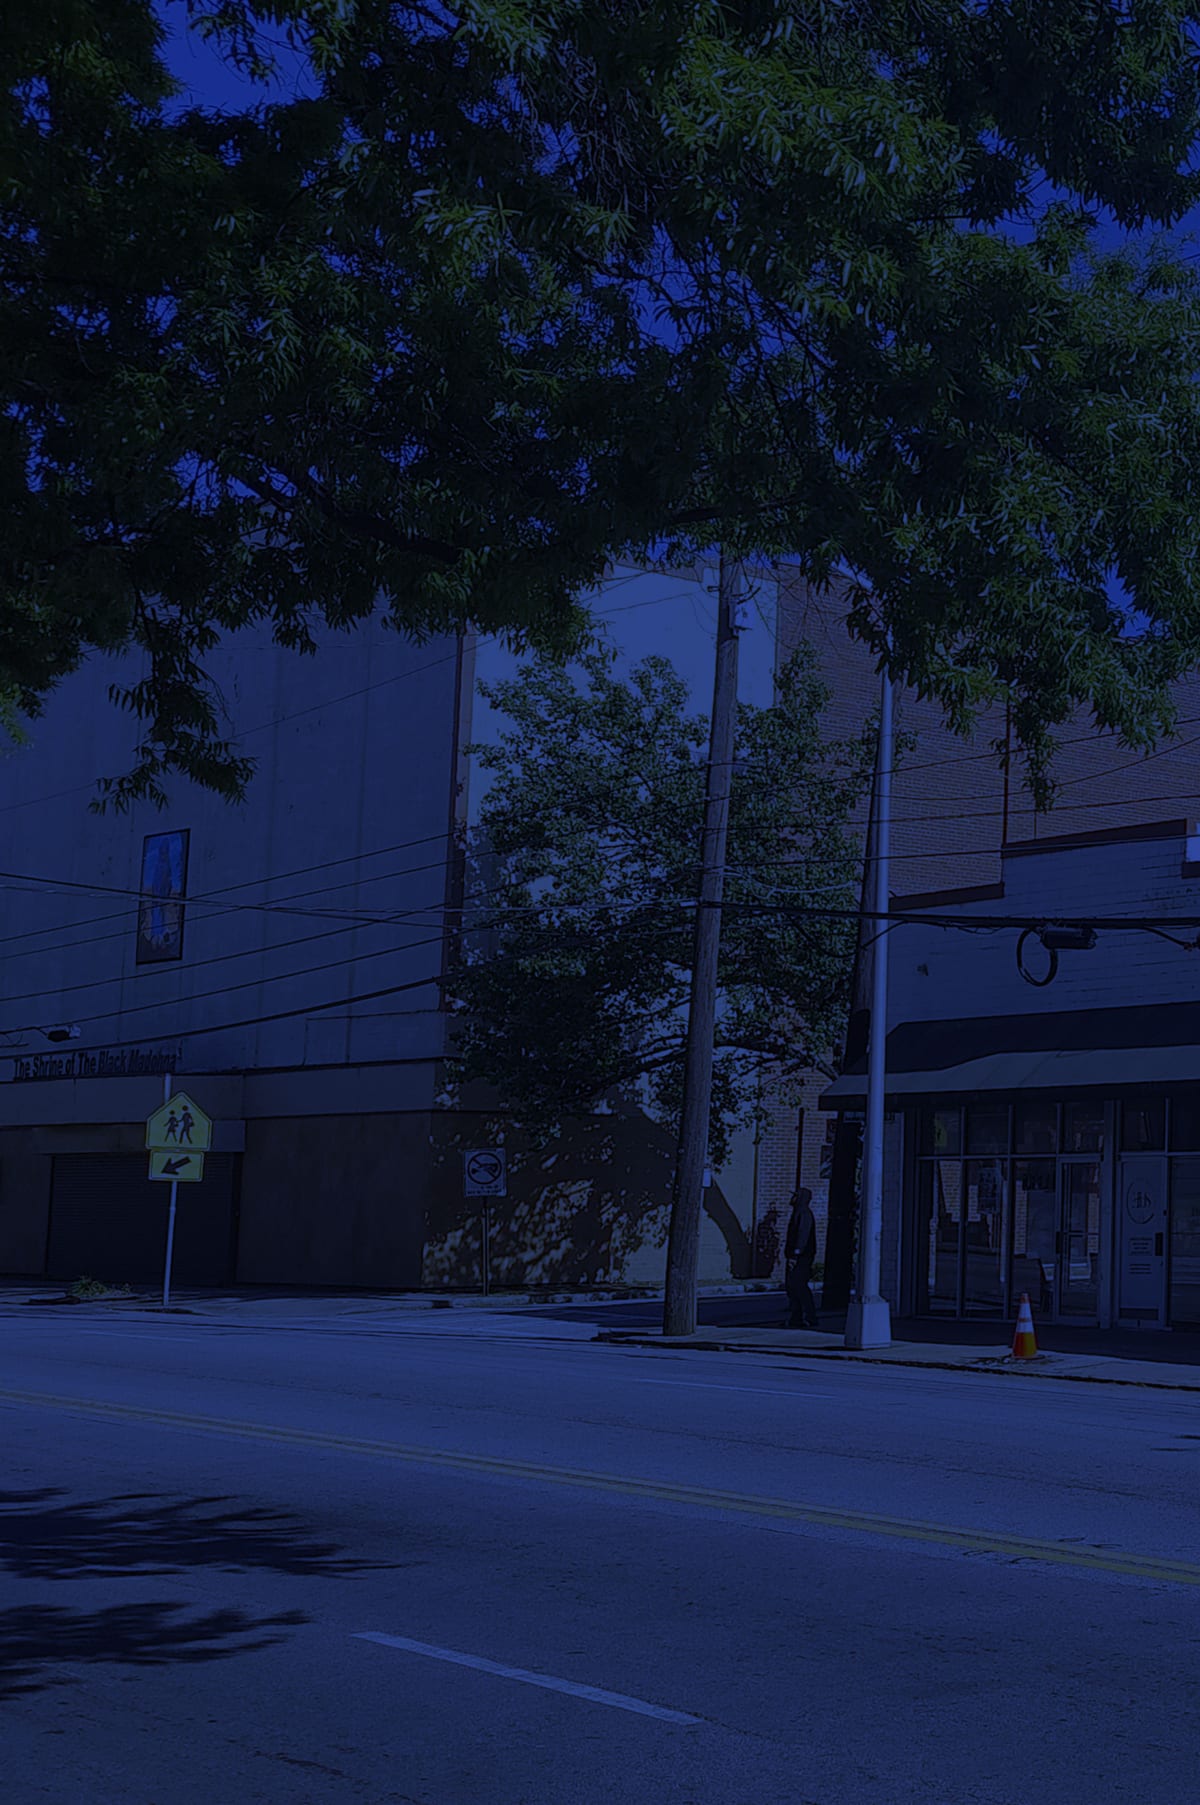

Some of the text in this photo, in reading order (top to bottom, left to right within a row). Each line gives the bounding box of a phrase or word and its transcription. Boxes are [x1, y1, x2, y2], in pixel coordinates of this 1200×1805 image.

[14, 1057, 31, 1082] The
[32, 1054, 64, 1079] Shrine
[65, 1052, 76, 1076] of
[78, 1052, 97, 1075] The
[98, 1050, 127, 1074] Black
